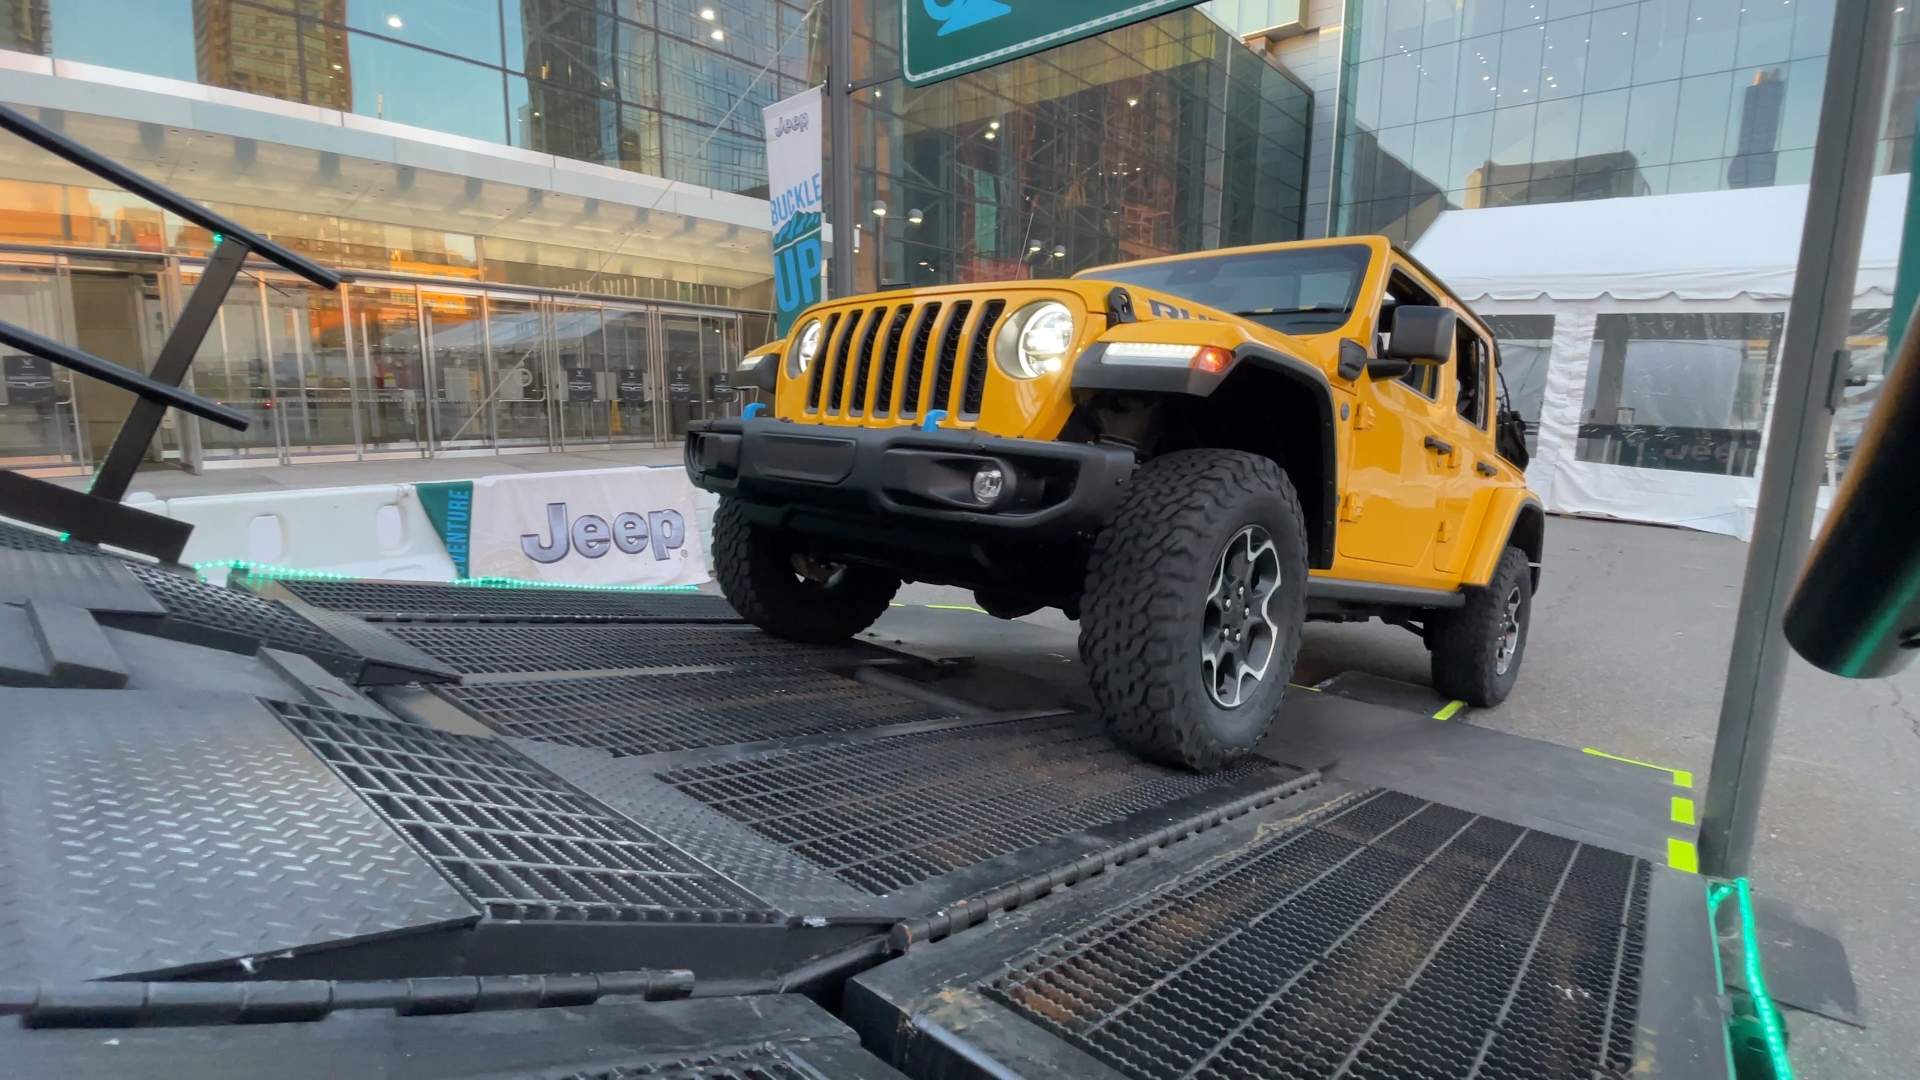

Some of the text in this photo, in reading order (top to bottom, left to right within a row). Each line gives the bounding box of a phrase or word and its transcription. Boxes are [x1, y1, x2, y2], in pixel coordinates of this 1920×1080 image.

[774, 112, 809, 138] Jeep
[770, 172, 822, 226] BUCKLE
[775, 238, 821, 313] UP
[1663, 441, 1748, 464] Jee
[520, 502, 686, 565] Jeep
